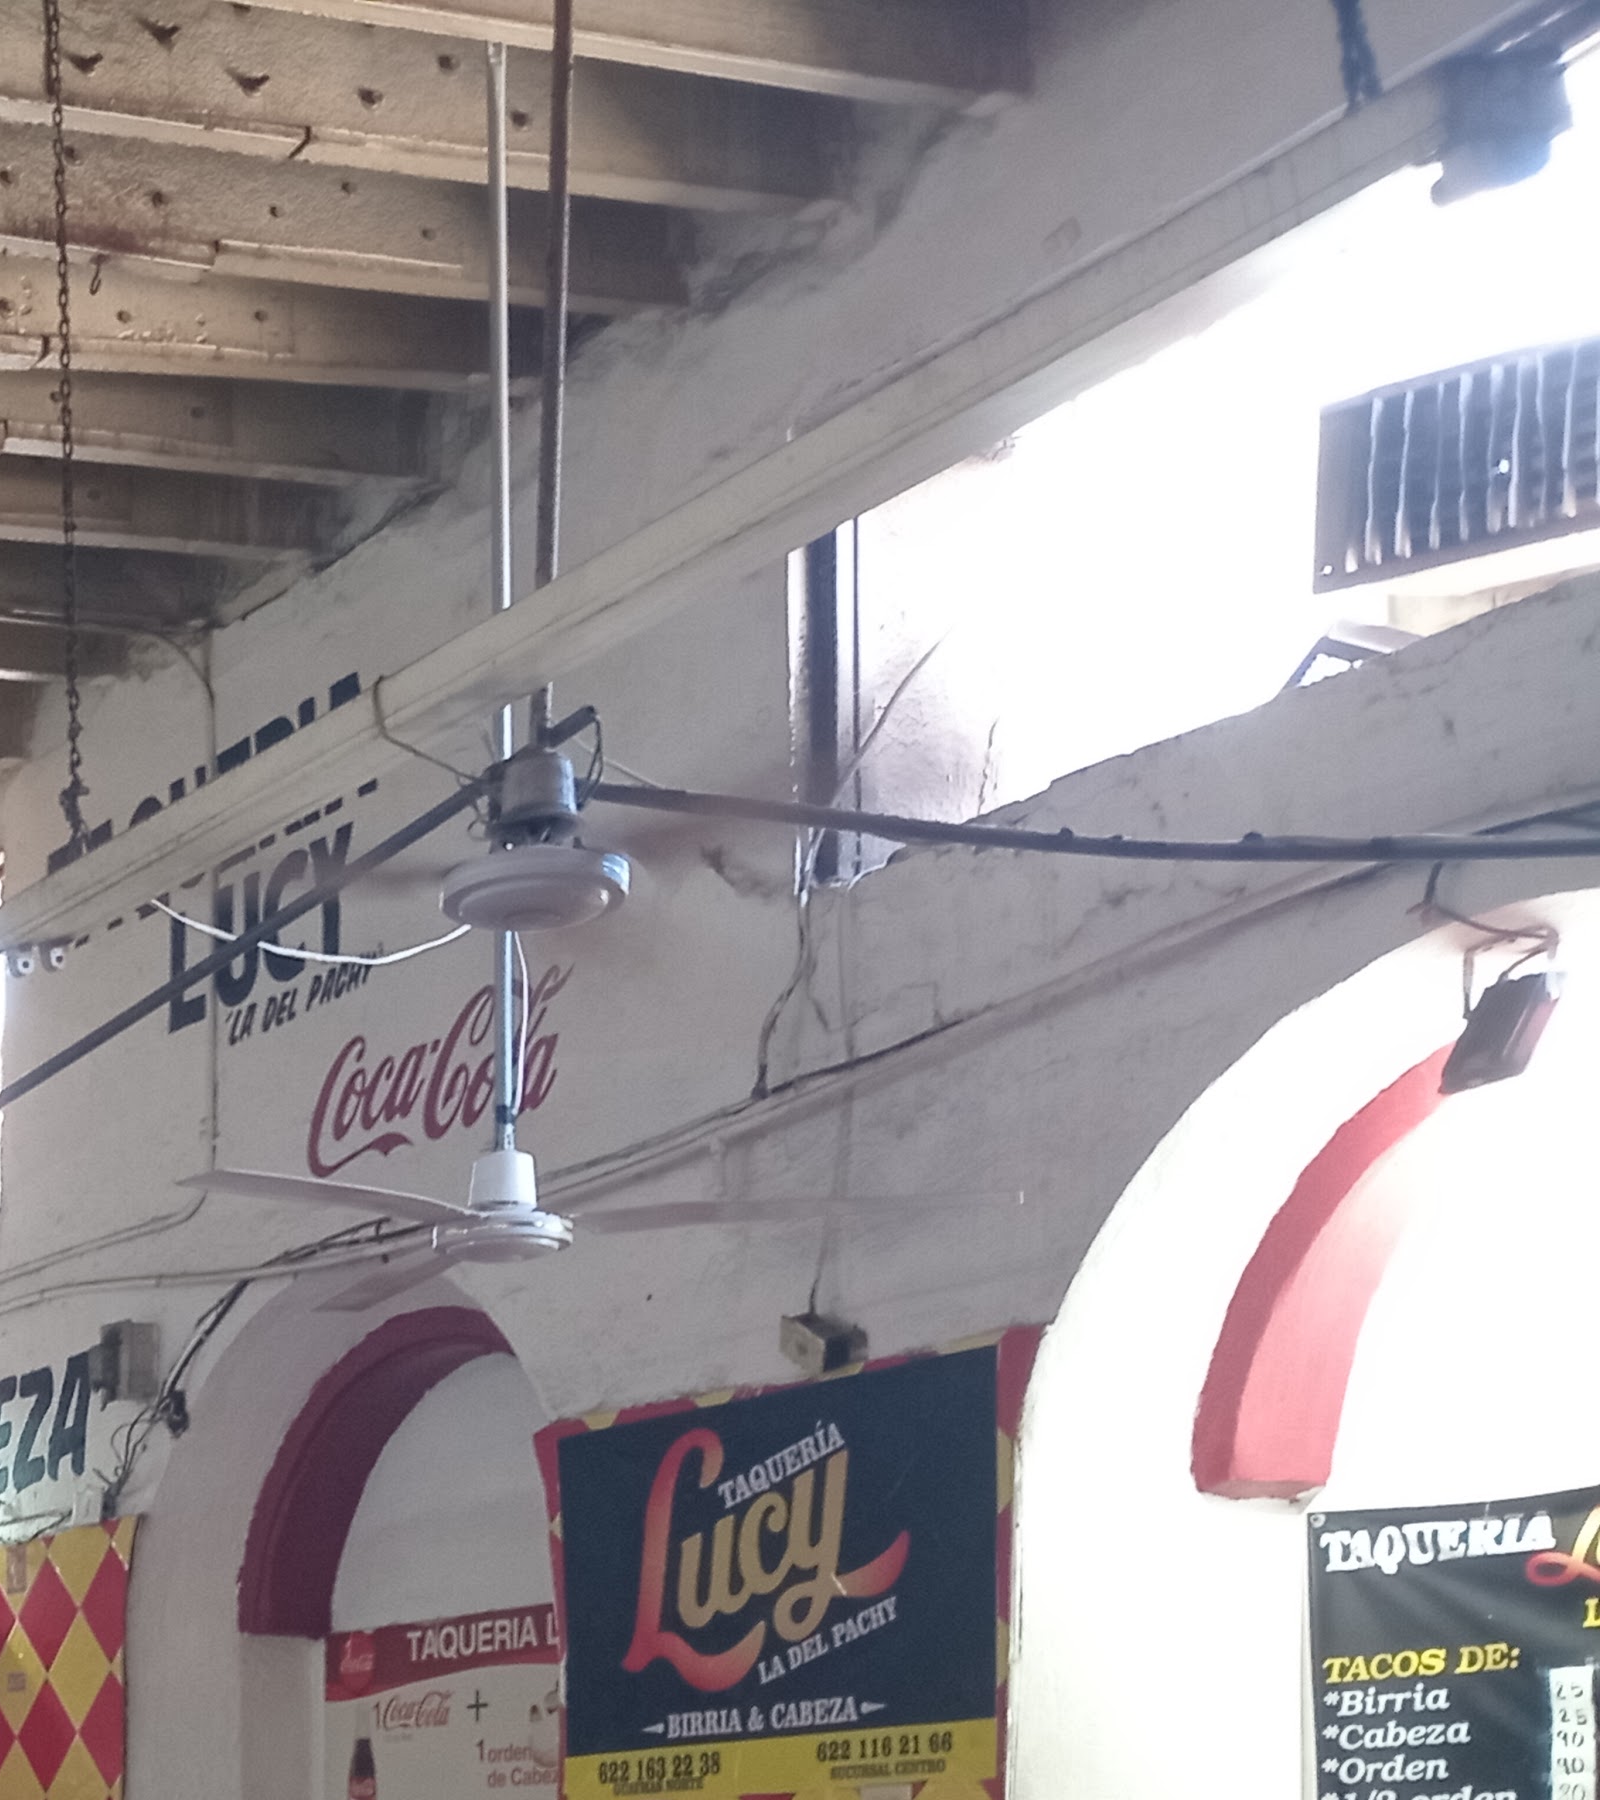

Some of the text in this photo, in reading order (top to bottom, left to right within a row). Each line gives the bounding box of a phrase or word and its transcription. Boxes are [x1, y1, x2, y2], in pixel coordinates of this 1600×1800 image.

[262, 988, 298, 1033] DEL
[718, 1420, 845, 1509] TAQUERÍA
[621, 1428, 910, 1692] Lucy
[1319, 1513, 1556, 1575] TAQUERIA
[407, 1616, 538, 1662] TAQUERIA
[758, 1597, 897, 1685] LA DEL PACHY
[1322, 1643, 1520, 1684] TACOS DE:
[667, 1697, 859, 1739] BIRRIA & CABEZA
[599, 1760, 629, 1784] 622
[638, 1756, 666, 1781] 163
[673, 1753, 693, 1777] 22
[817, 1739, 850, 1762] 622
[899, 1733, 920, 1755] 21
[487, 1768, 506, 1789] de
